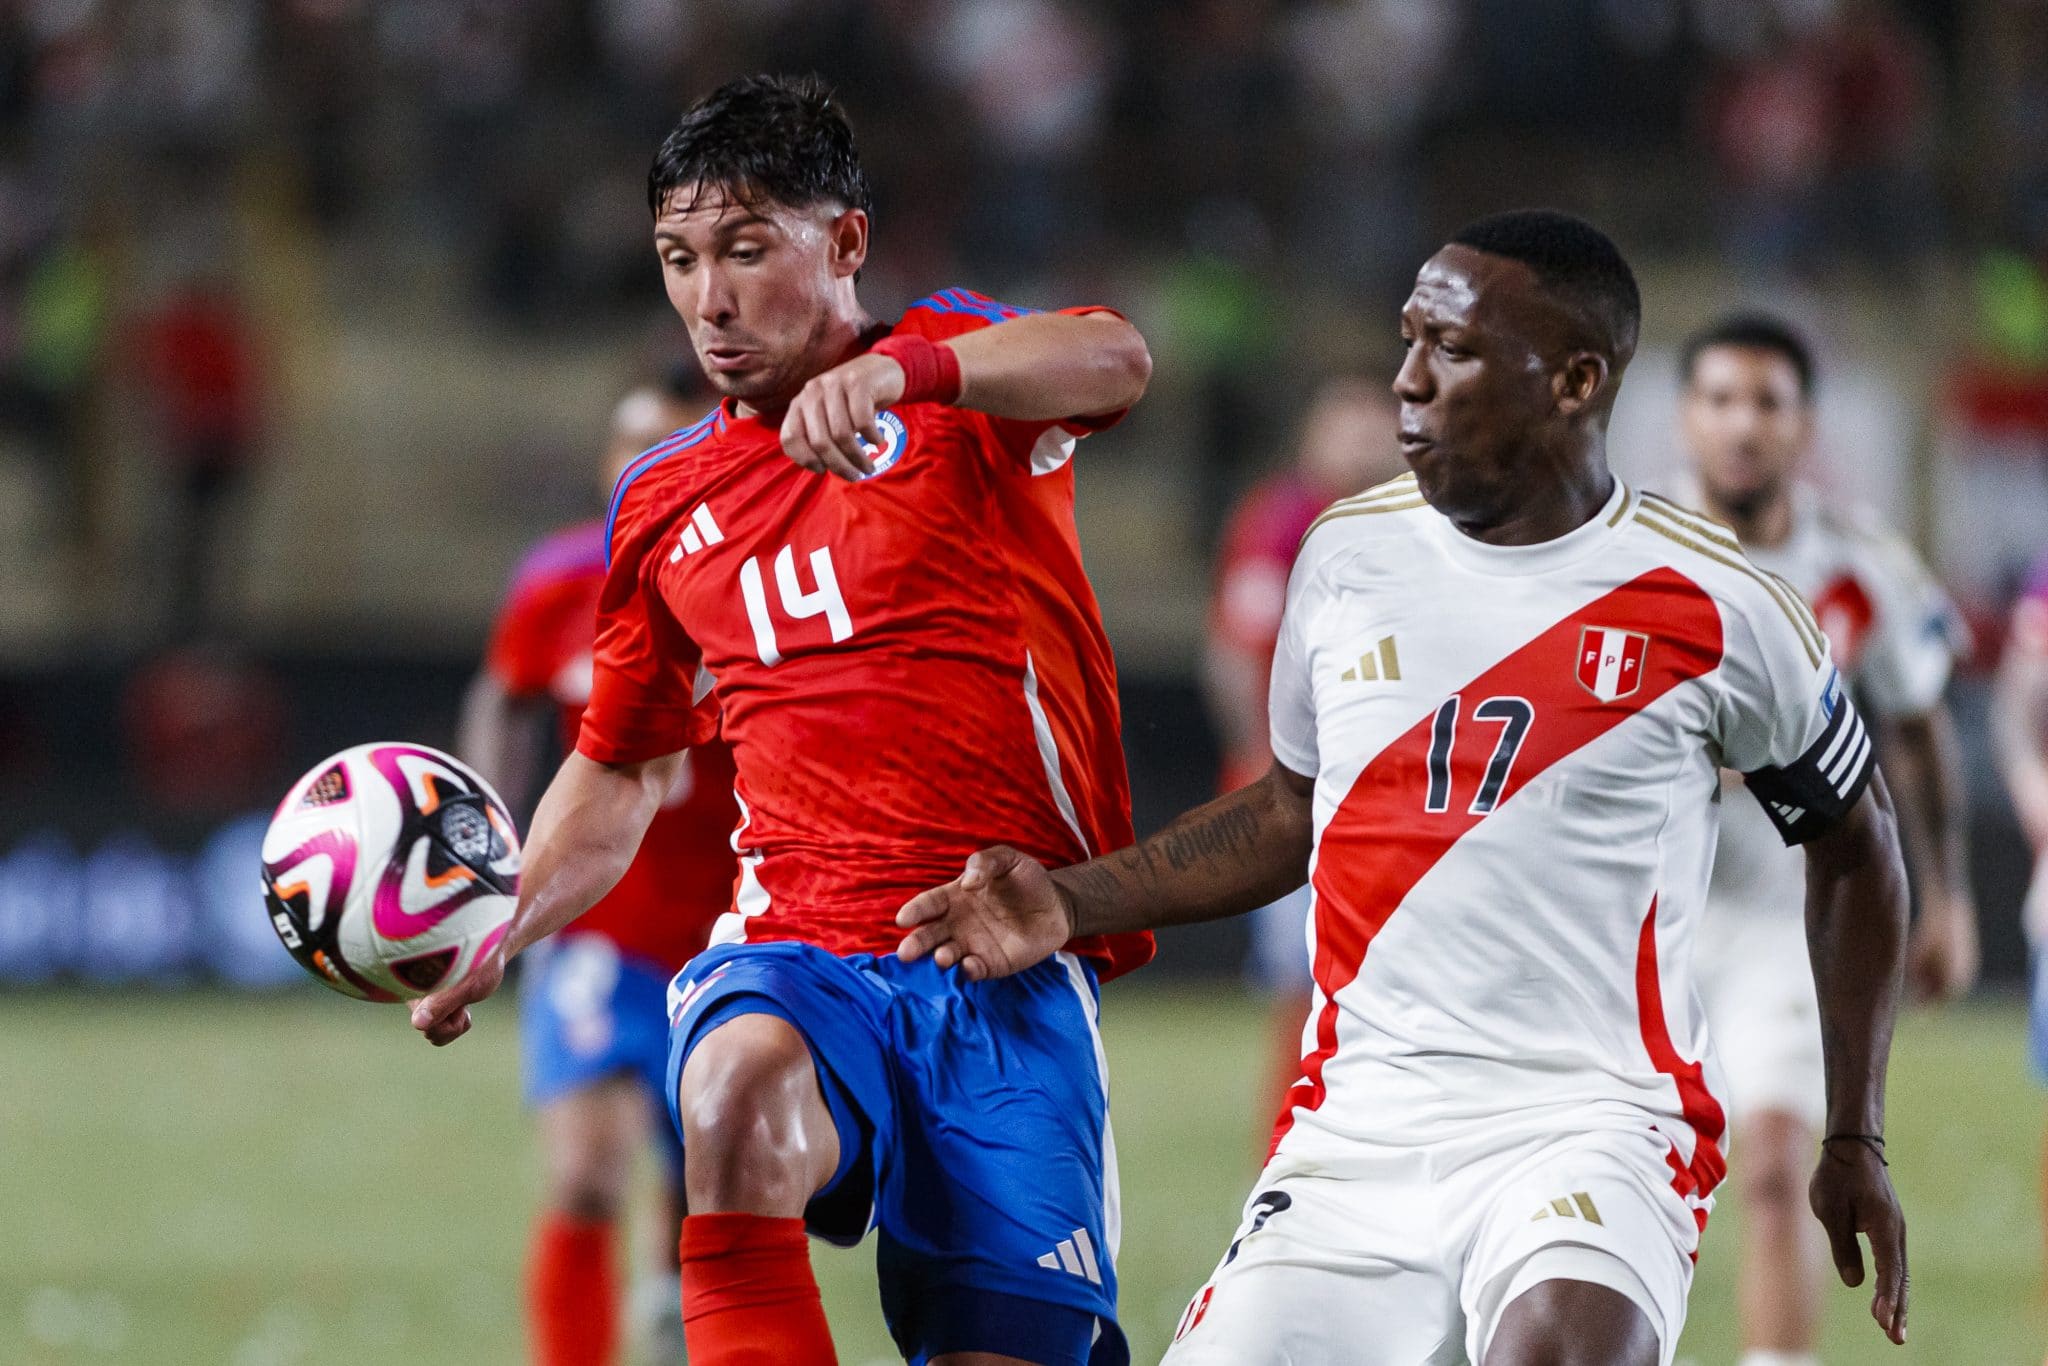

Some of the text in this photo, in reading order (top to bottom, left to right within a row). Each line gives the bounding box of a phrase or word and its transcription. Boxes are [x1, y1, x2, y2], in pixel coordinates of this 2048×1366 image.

[739, 543, 854, 669] 14
[1585, 650, 1636, 673] FPF
[1424, 694, 1535, 815] 17
